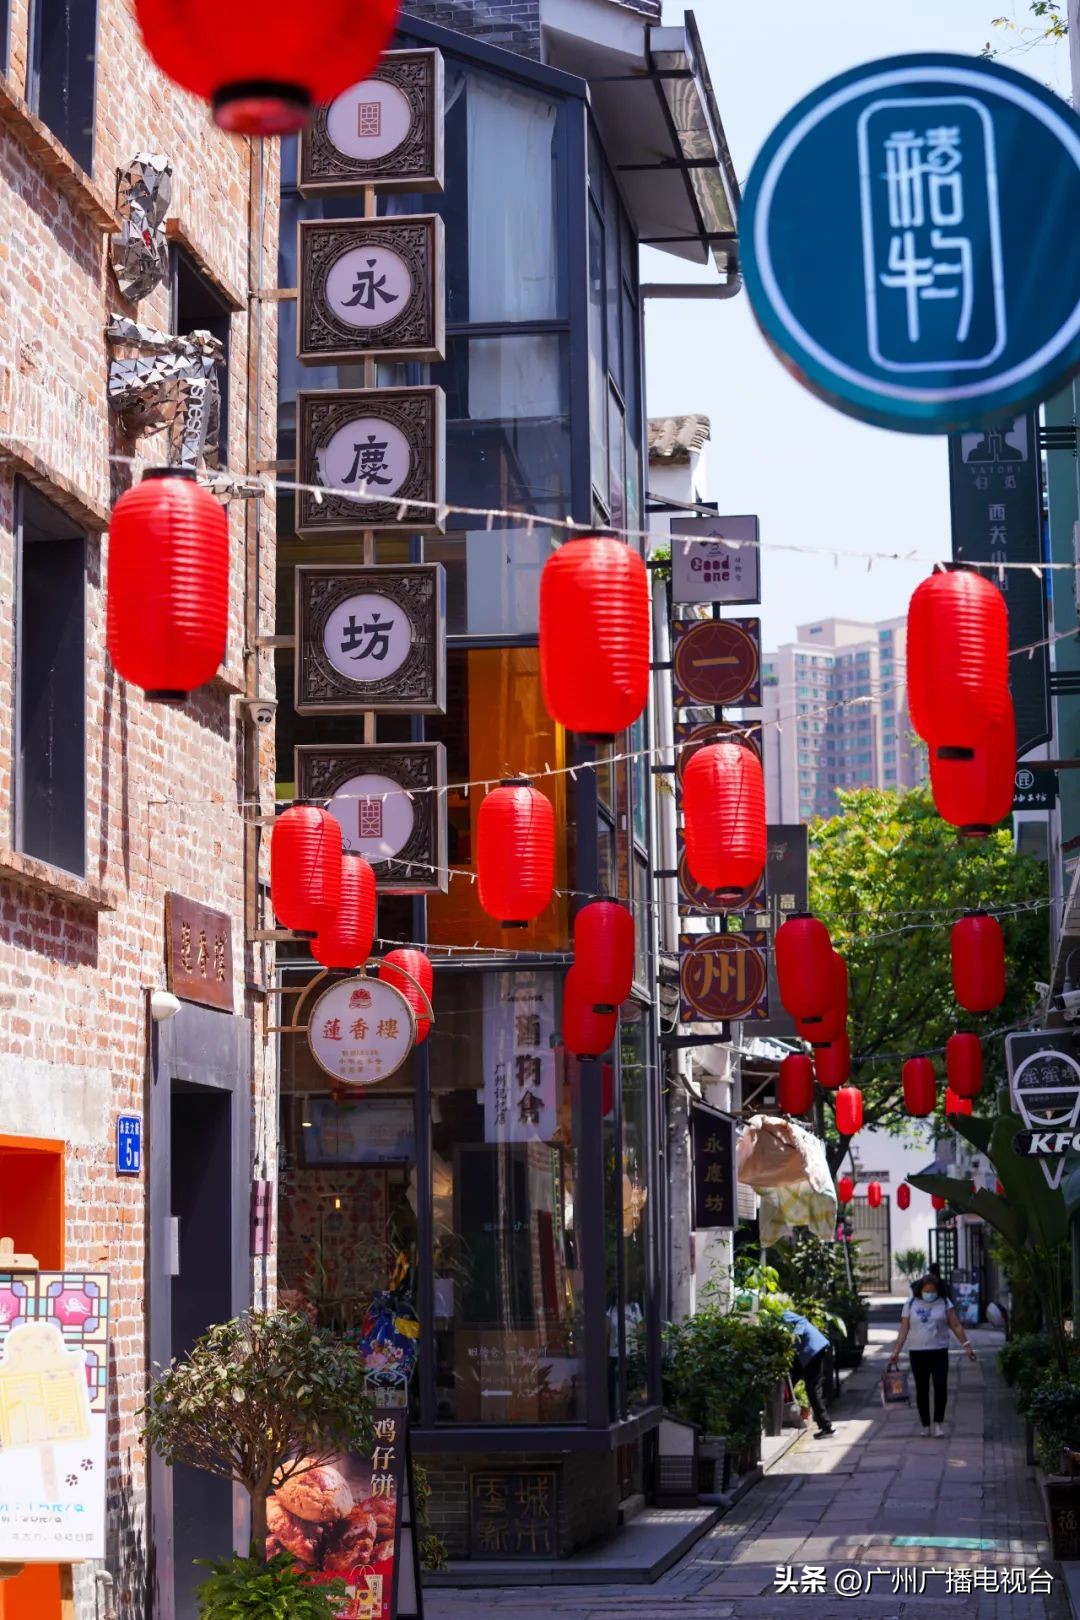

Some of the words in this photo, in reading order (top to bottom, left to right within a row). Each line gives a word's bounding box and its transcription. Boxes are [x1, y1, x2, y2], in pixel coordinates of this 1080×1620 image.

[340, 258, 399, 310] 永
[341, 434, 394, 486] 慶
[340, 613, 395, 661] 坊
[322, 1017, 399, 1041] 蓮香樓
[126, 1138, 133, 1167] 5
[370, 1417, 397, 1499] 鸡仔饼
